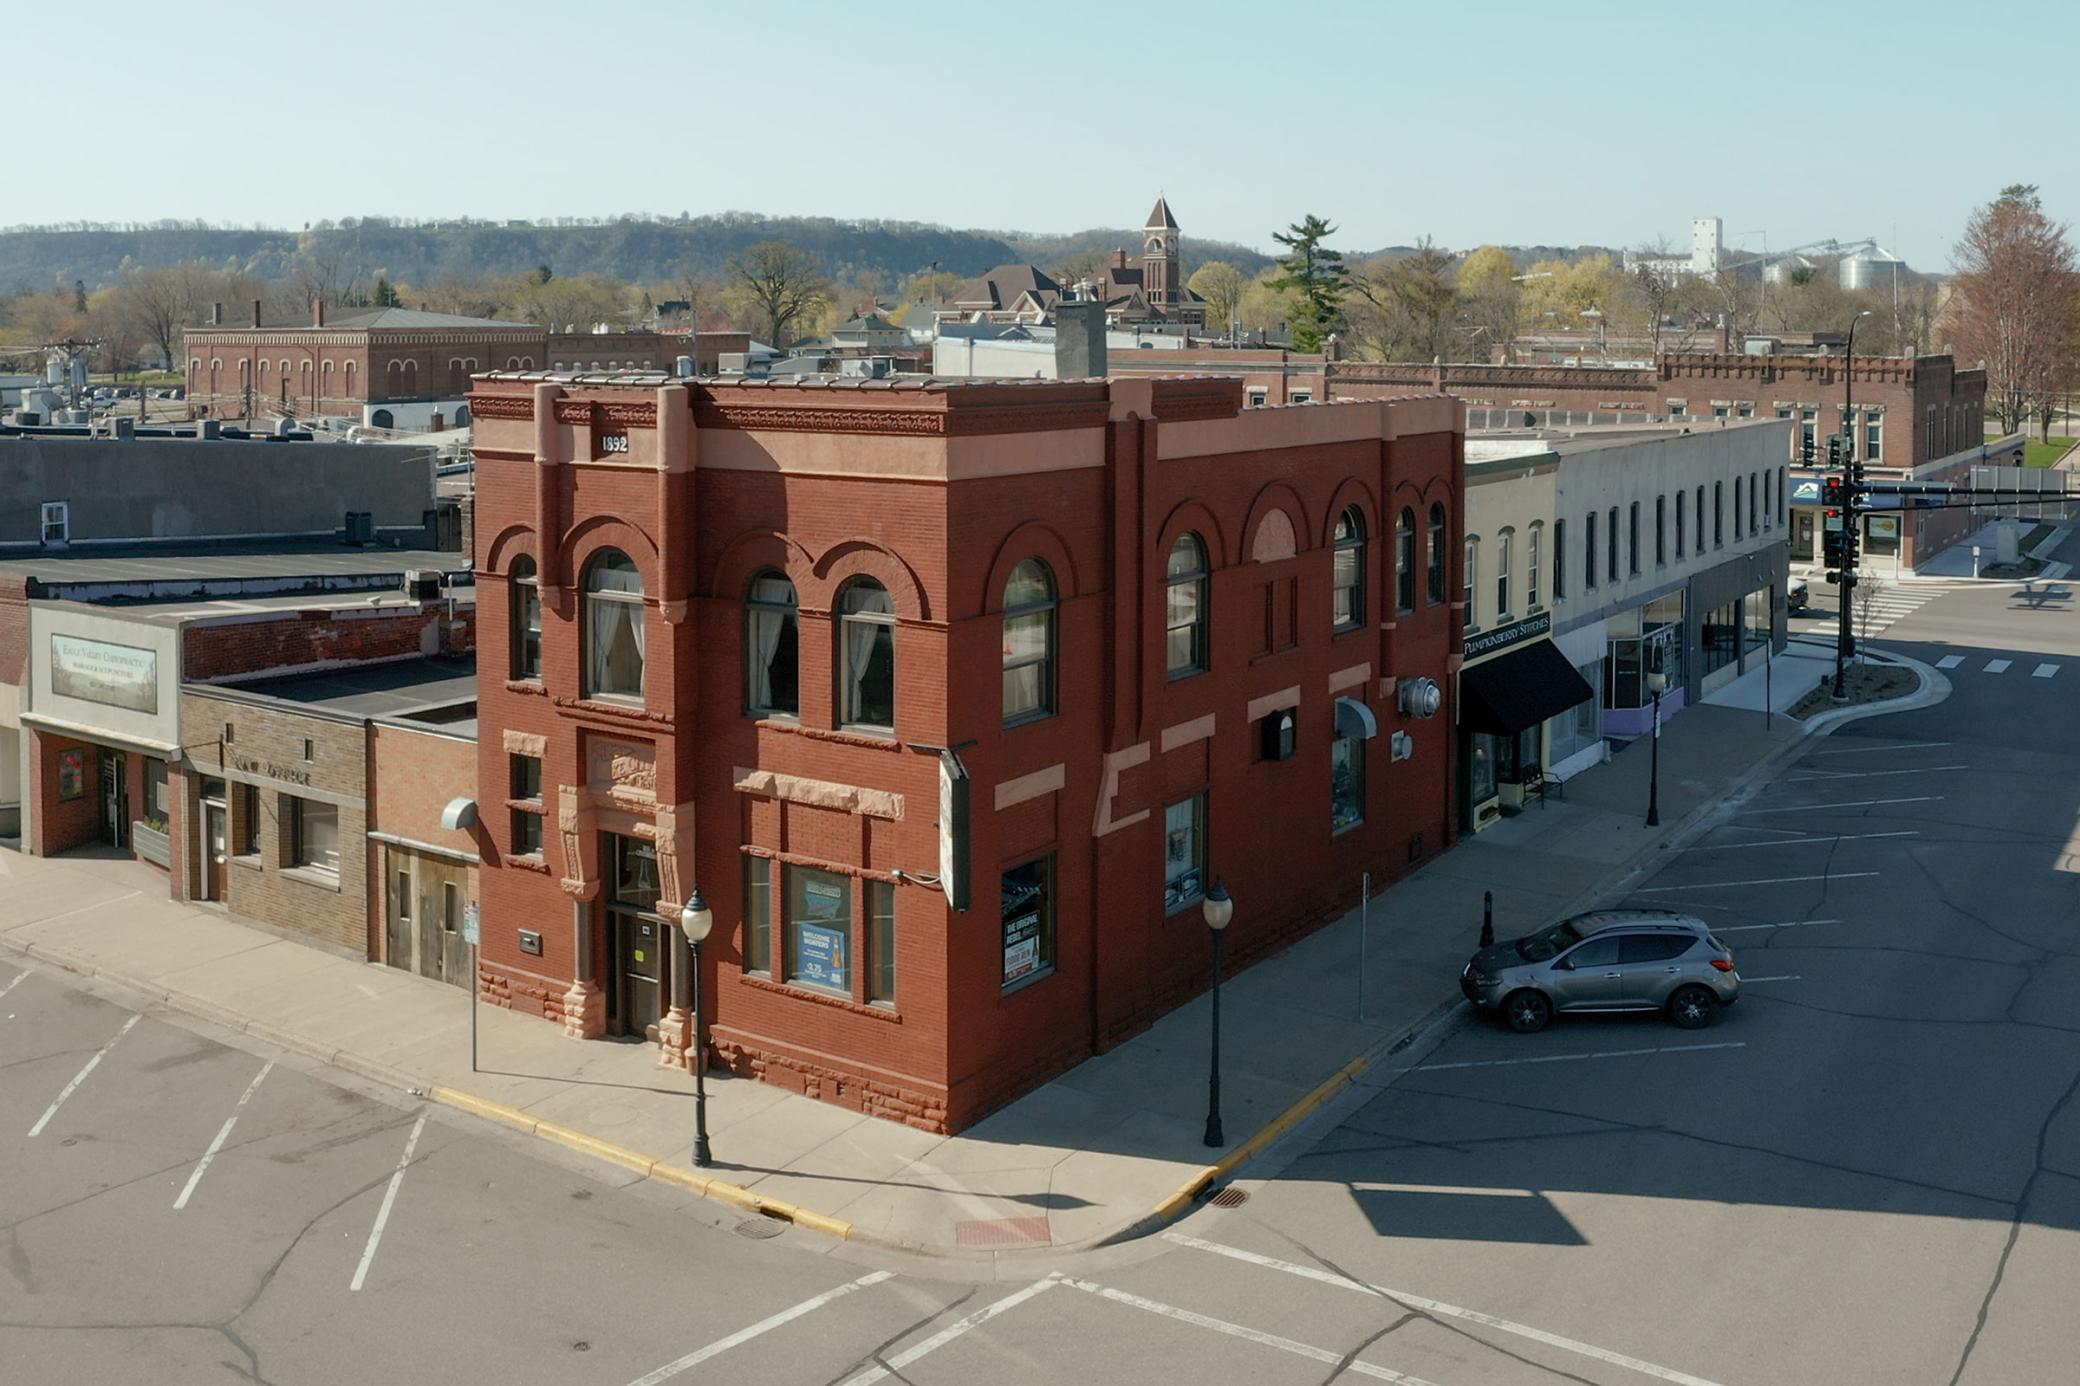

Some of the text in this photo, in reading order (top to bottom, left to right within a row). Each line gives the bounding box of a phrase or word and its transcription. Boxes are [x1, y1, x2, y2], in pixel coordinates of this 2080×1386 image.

[603, 436, 628, 451] 1892
[1464, 617, 1549, 655] PUMPKINBERRY STITCHES
[62, 644, 146, 668] EAGLE VALLEY CHIROPRACTIC
